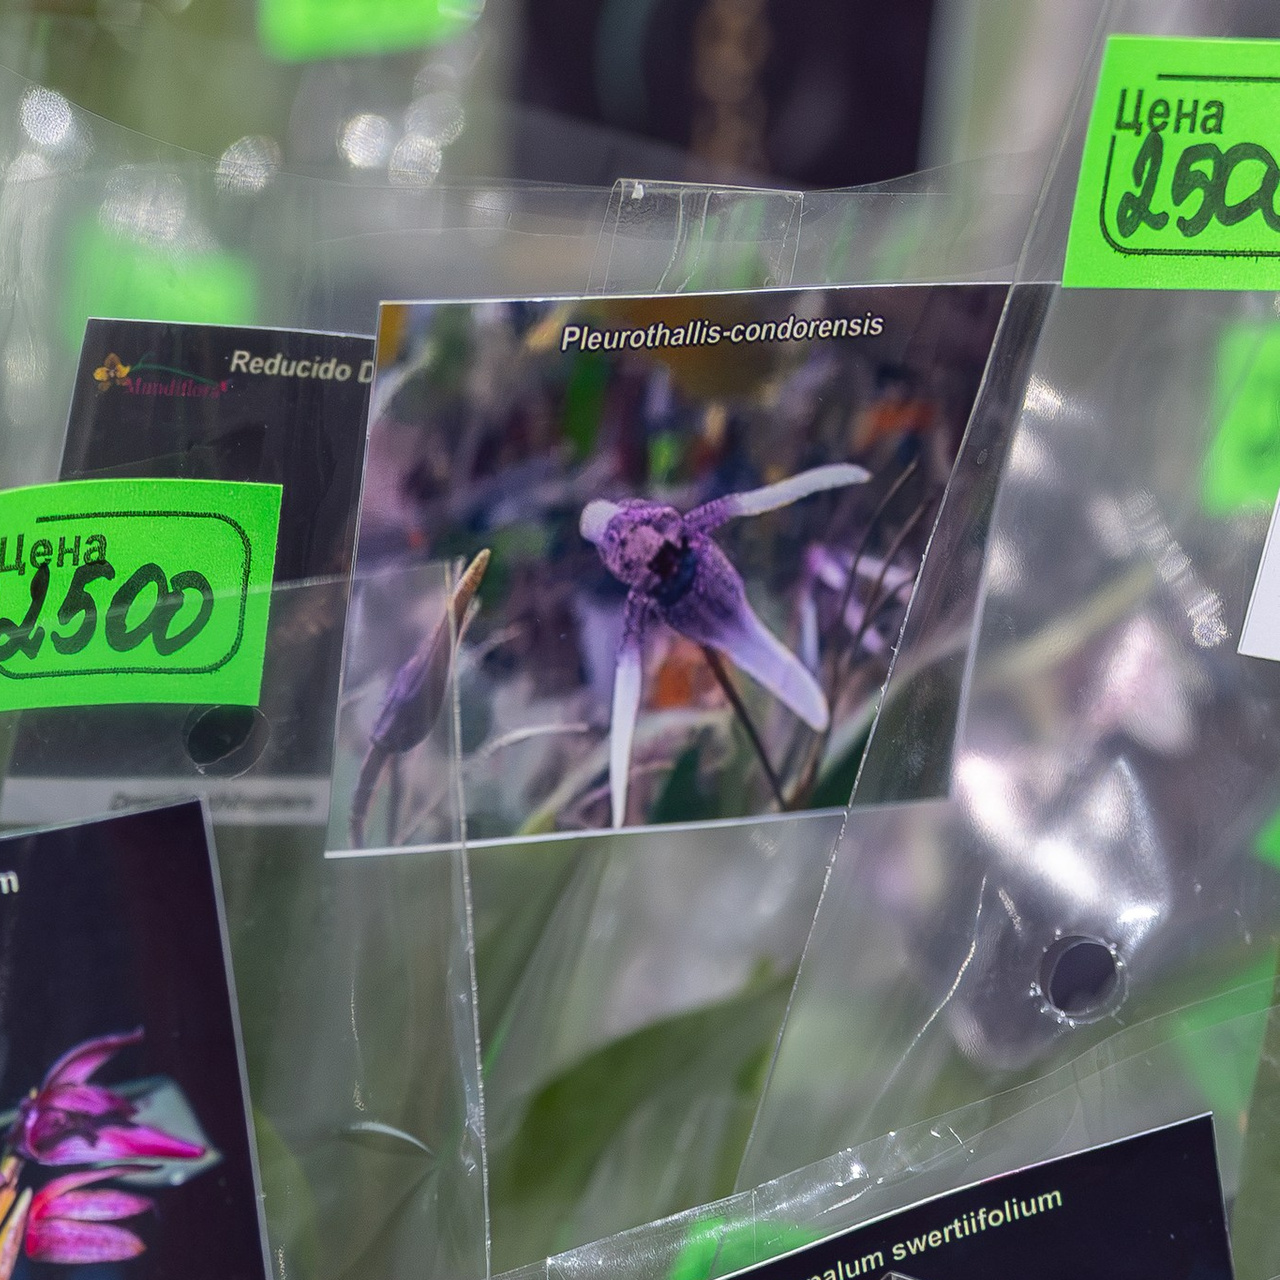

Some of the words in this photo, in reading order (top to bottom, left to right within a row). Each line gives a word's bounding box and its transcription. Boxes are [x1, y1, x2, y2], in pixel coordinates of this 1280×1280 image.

[1115, 88, 1225, 136] Цена
[1117, 131, 1280, 238] 250
[561, 312, 885, 351] Pleurothallis-condorensis
[231, 350, 352, 382] Reducido
[358, 359, 374, 384] D
[891, 1189, 1064, 1262] swertiifolium
